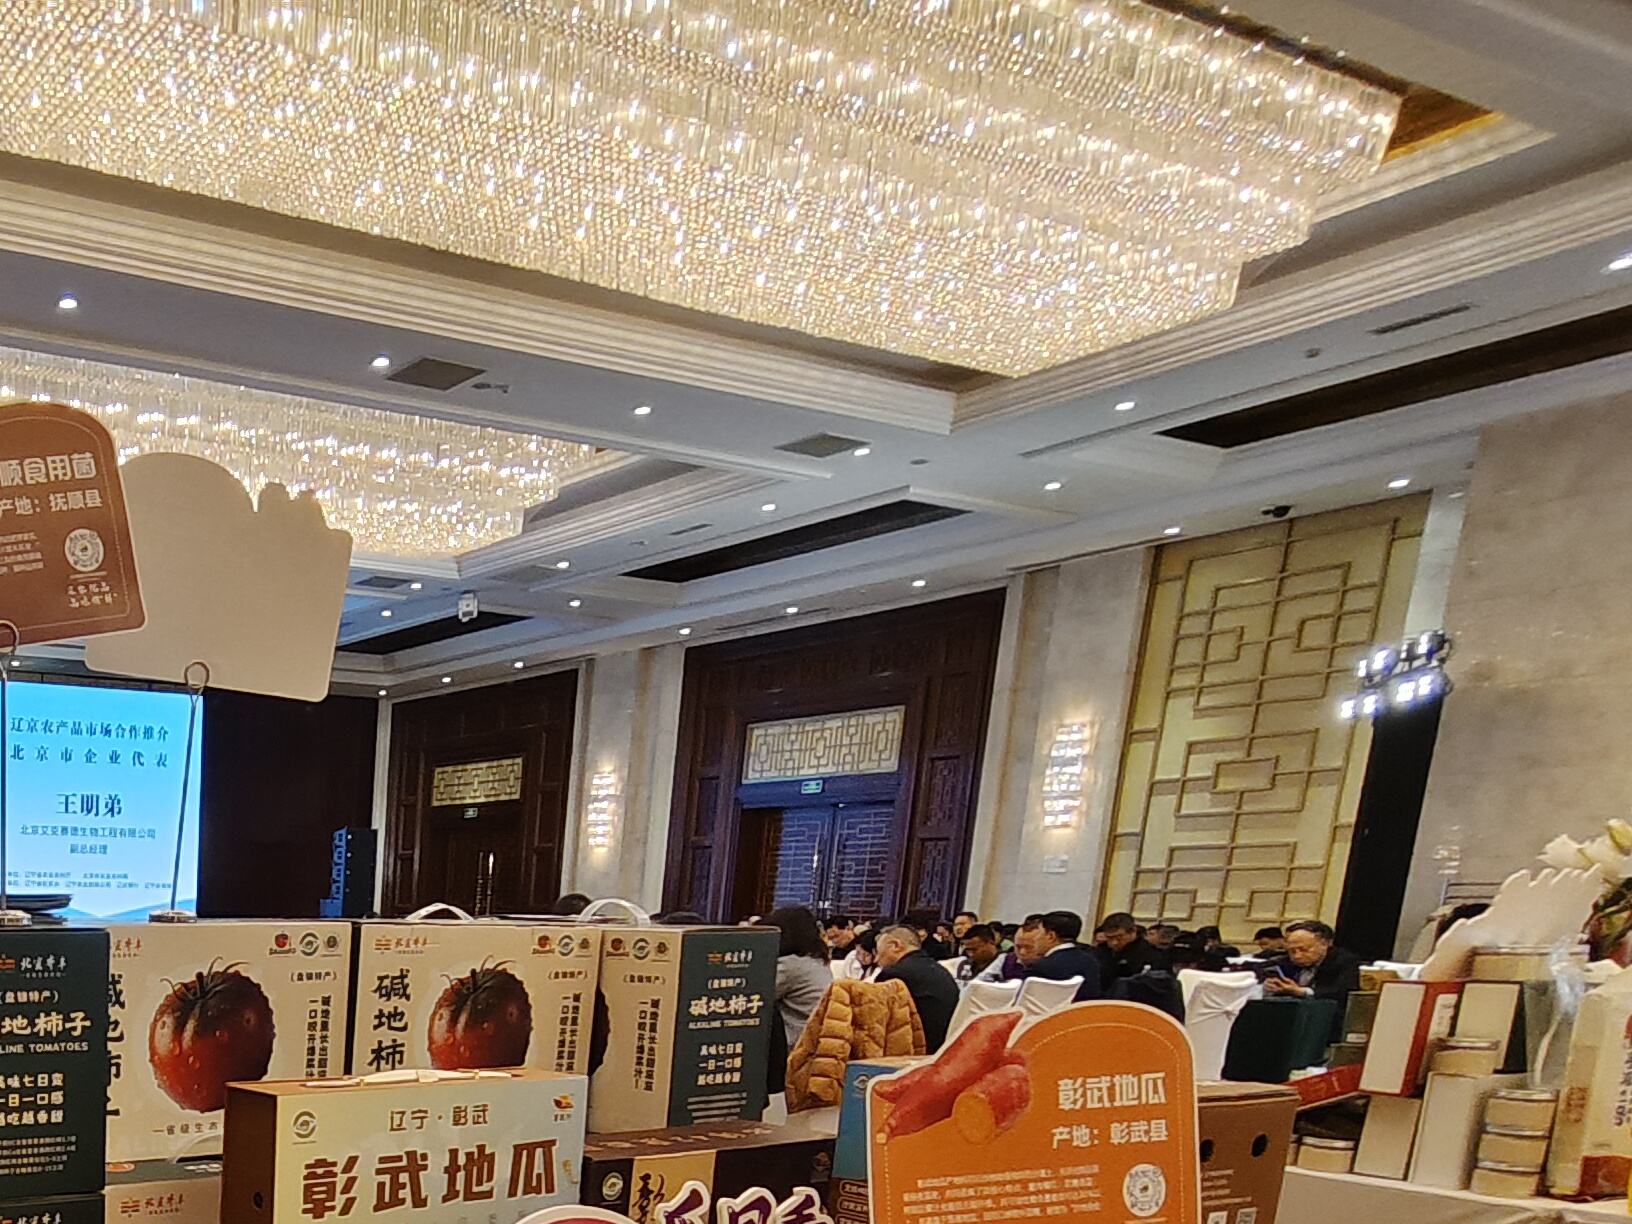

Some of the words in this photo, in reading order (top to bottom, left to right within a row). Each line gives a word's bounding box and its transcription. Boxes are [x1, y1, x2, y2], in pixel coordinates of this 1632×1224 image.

[10, 717, 169, 742] 辽京农产品市场合作推介
[10, 744, 168, 768] 北京市企业代表
[56, 793, 123, 818] 王明弟
[70, 843, 108, 855] 副总经理
[689, 994, 764, 1016] 碱地柿子
[367, 967, 411, 1072] 碱地柿
[29, 1041, 89, 1053] TOMATOES
[1058, 1072, 1167, 1111] 彰武地瓜
[1051, 1119, 1169, 1150] 产地：彰武县
[301, 1138, 558, 1220] 彰武地瓜
